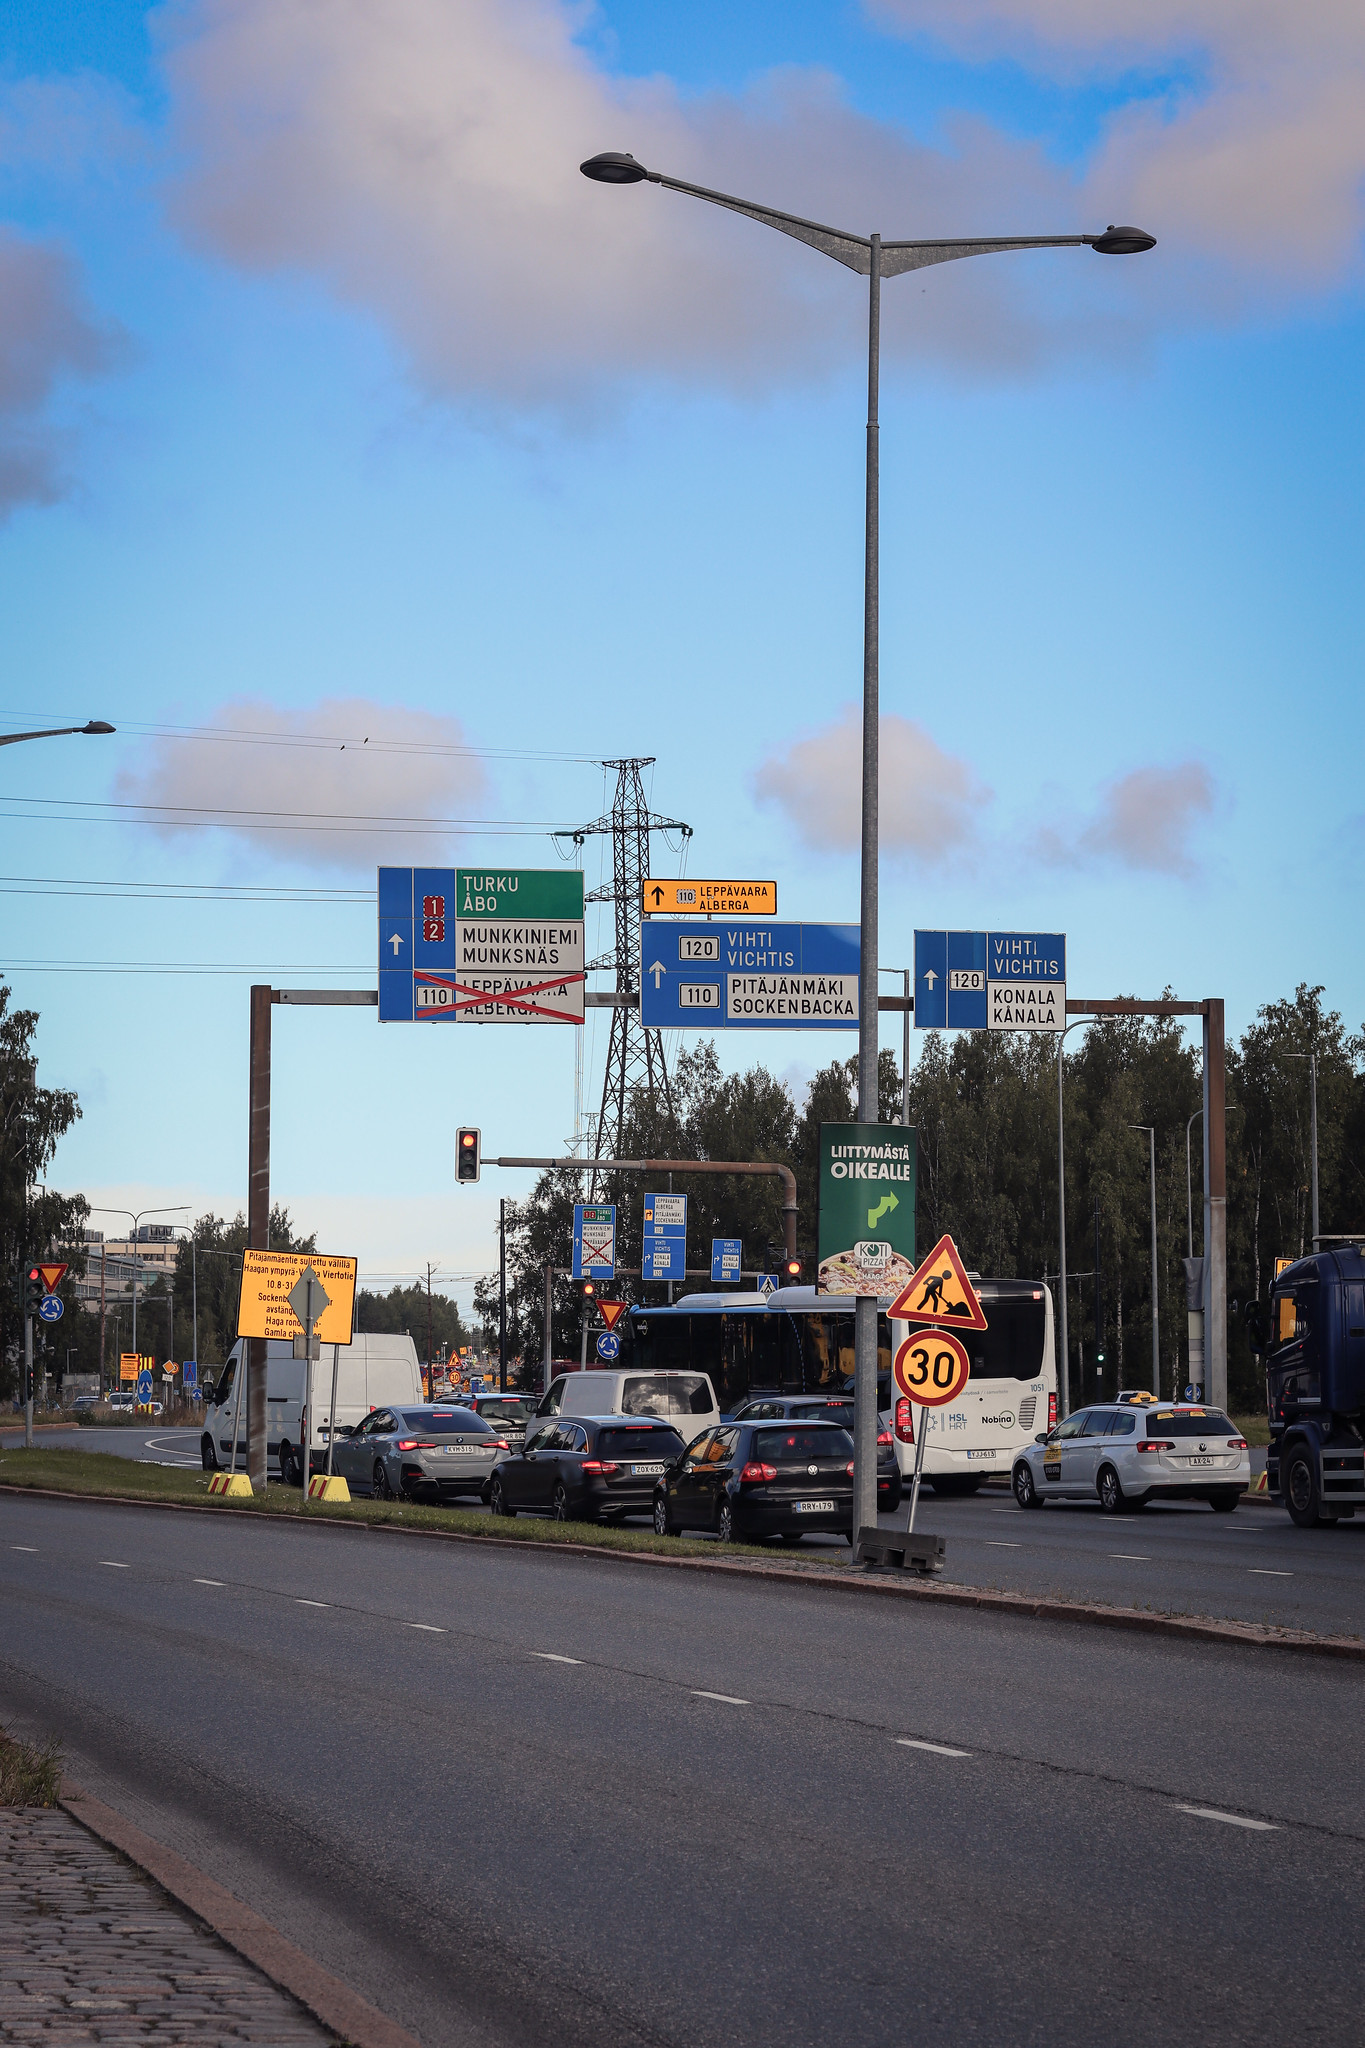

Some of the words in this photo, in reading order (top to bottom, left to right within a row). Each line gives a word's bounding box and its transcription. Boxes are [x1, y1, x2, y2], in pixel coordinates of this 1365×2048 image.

[463, 876, 518, 892] TURKU
[700, 885, 768, 897] LEPPÄVAARA
[463, 892, 497, 912] ÅBO
[680, 892, 692, 901] 110
[431, 900, 437, 915] 1
[700, 900, 749, 910] ALBERGA
[430, 924, 439, 939] 2
[463, 928, 578, 945] MUNKKINIEMI
[727, 932, 772, 947] VIHTI
[686, 941, 713, 956] 120
[994, 940, 1037, 955] VIHTI
[463, 947, 559, 964] MUNKSNÄS
[727, 951, 794, 967] VICHTIS
[994, 959, 1059, 975] VICHTIS
[732, 977, 843, 995] PITÄJÄNMÄKI
[954, 973, 980, 988] 120
[422, 989, 447, 1004] 110
[688, 988, 711, 1003] 110
[994, 989, 1055, 1004] KONALA
[733, 999, 854, 1015] SOCKENBACKA
[994, 1005, 1055, 1023] KÅNALA
[831, 1144, 910, 1160] LIITTYMÄSTÄ
[830, 1162, 910, 1181] OIKEALLE
[860, 1244, 887, 1256] KOTI
[248, 1252, 298, 1264] Pitäjänmäentie
[300, 1258, 326, 1267] suljettu
[328, 1260, 350, 1268] välillä
[244, 1264, 268, 1274] Haagan
[322, 1270, 354, 1280] Viertotie
[266, 1316, 284, 1326] Haga
[264, 1328, 287, 1338] Gamla
[908, 1348, 955, 1388] 30
[1030, 1384, 1044, 1392] 1051
[949, 1414, 967, 1422] HSL
[982, 1415, 1012, 1424] Nobina
[950, 1422, 967, 1430] HRT
[801, 1502, 832, 1511] RRY-179
